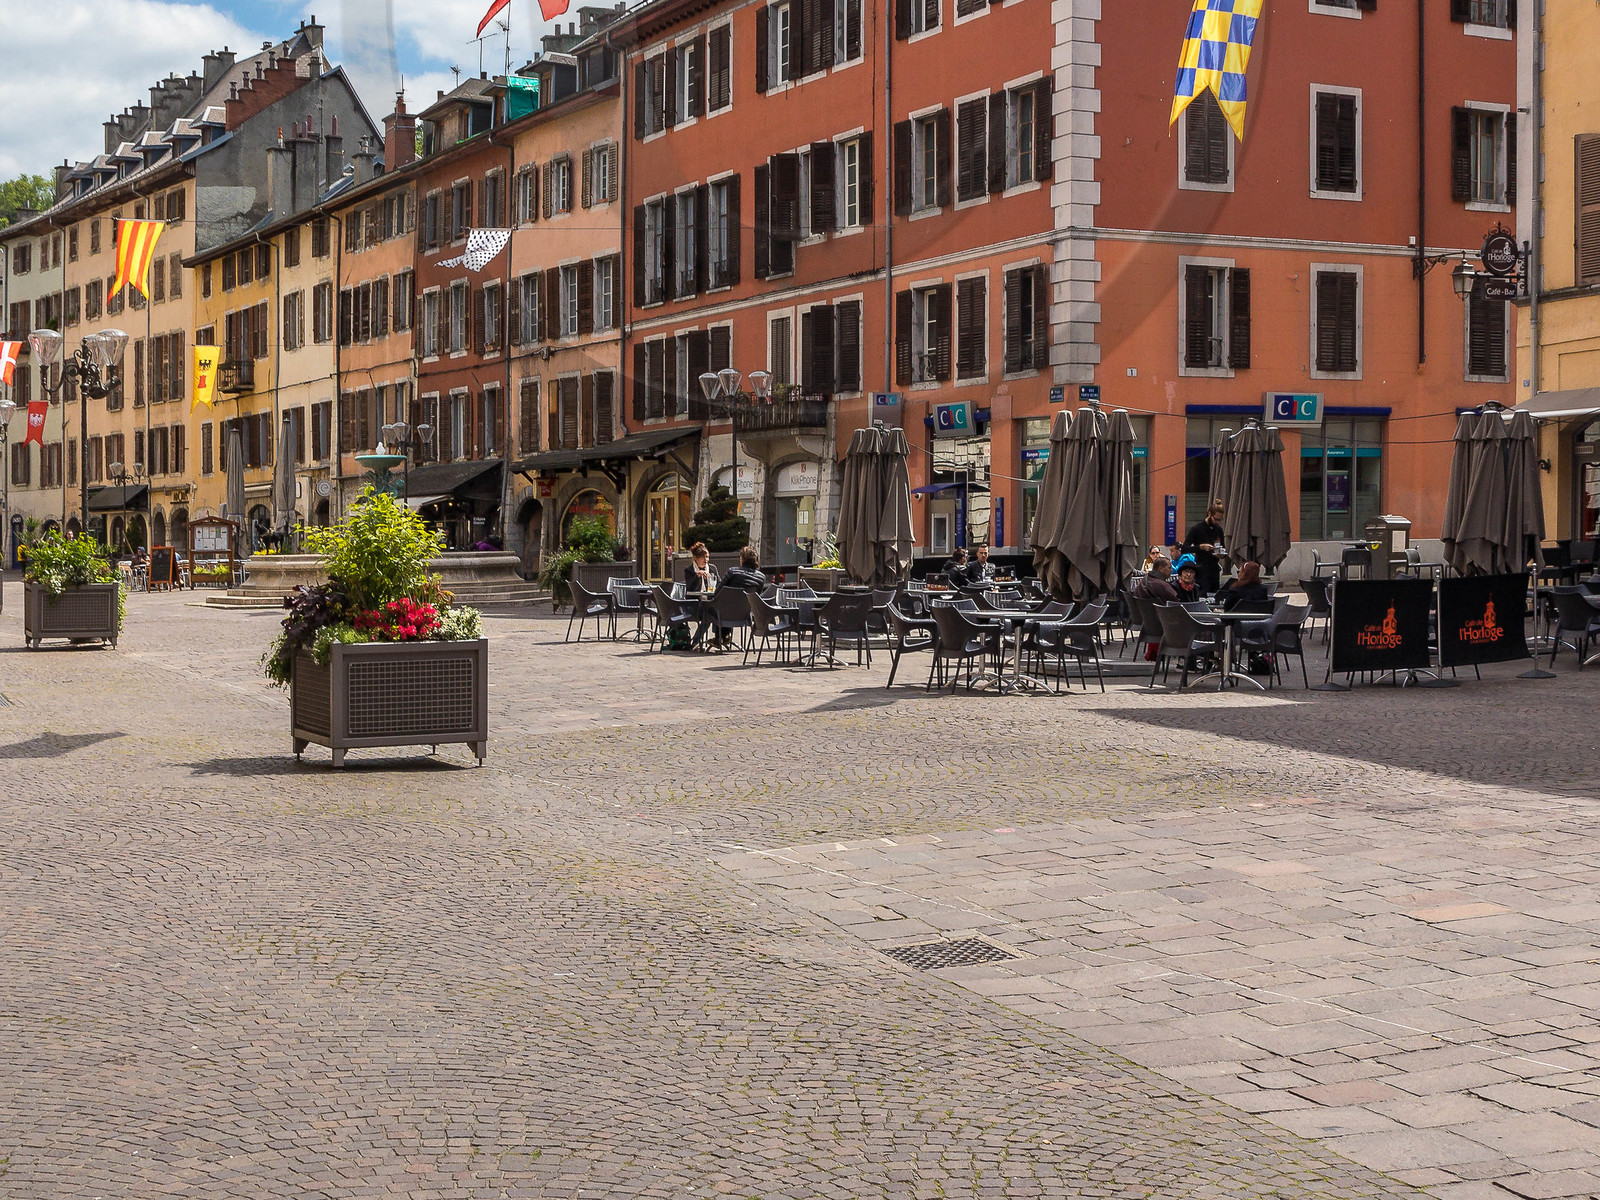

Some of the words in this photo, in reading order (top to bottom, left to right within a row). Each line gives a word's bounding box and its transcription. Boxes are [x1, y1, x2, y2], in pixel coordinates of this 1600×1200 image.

[1488, 253, 1515, 262] l'Horloge
[1278, 400, 1312, 416] CIC
[940, 409, 963, 425] CIC
[1357, 632, 1402, 648] l'Horloge
[1460, 626, 1503, 641] l'Horloge
